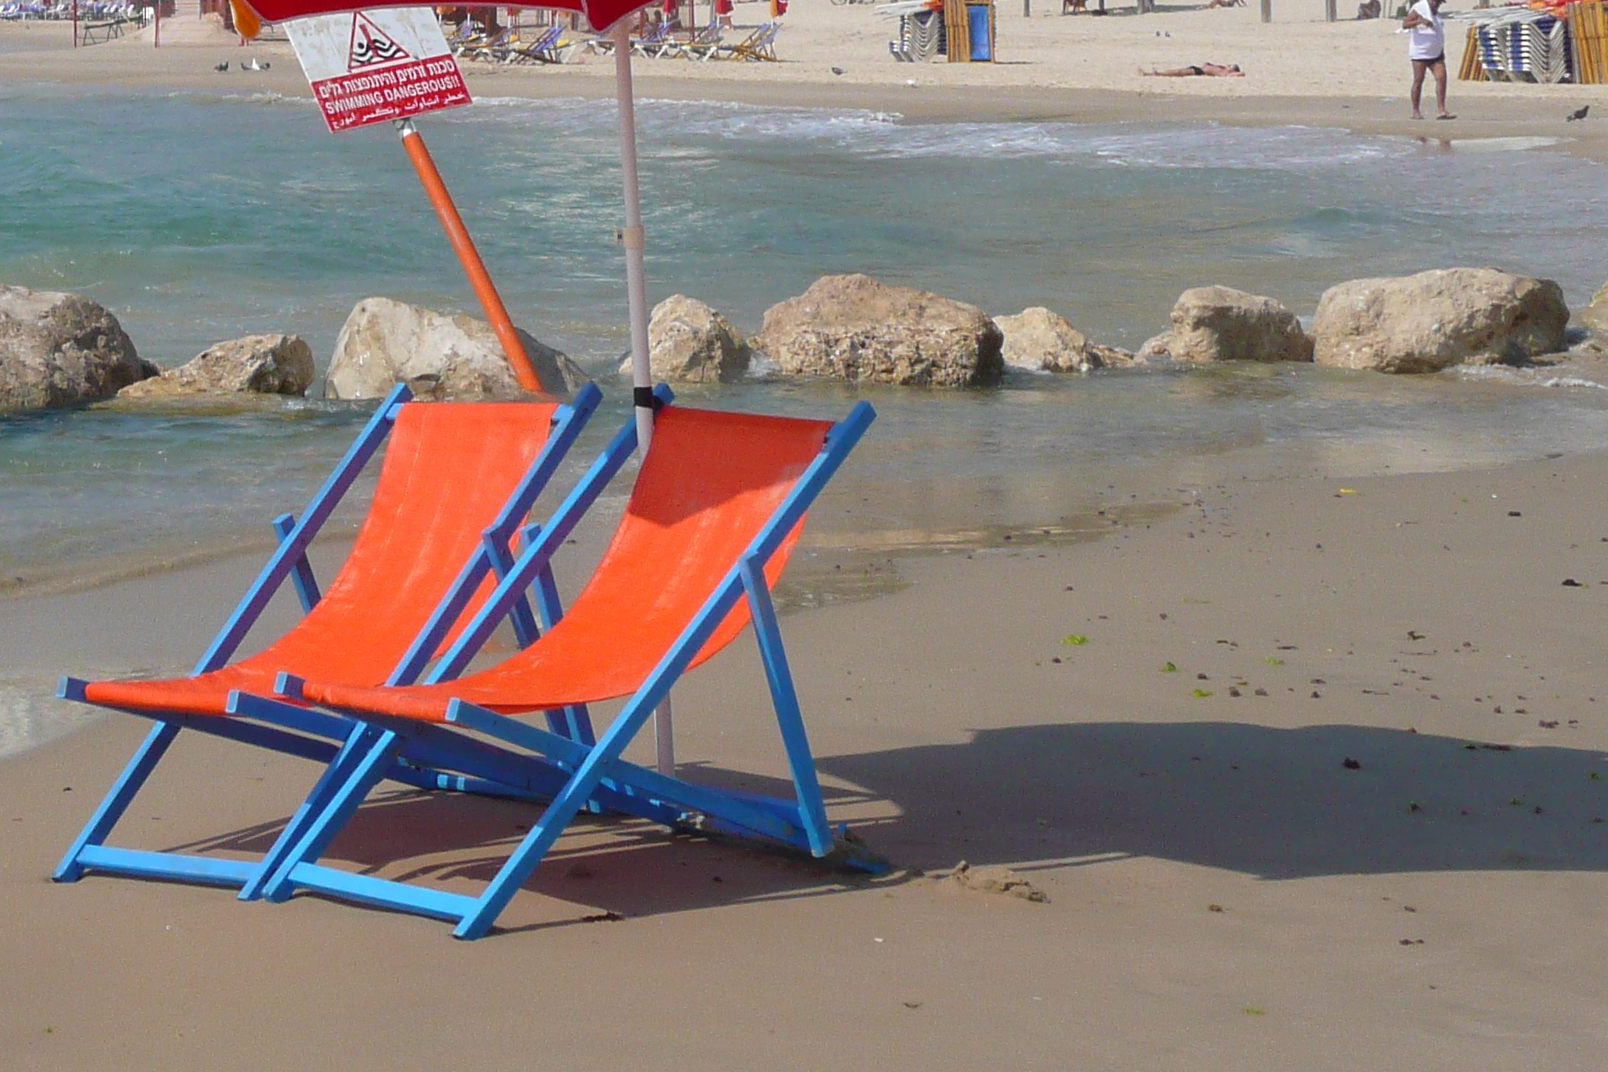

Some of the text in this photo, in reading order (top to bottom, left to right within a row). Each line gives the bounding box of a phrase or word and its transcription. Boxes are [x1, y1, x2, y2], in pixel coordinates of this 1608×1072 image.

[398, 65, 427, 84] זרמים
[428, 59, 456, 77] סכנת
[319, 81, 344, 99] גלים
[325, 75, 461, 115] SWIMMING DANGEROUS!!
